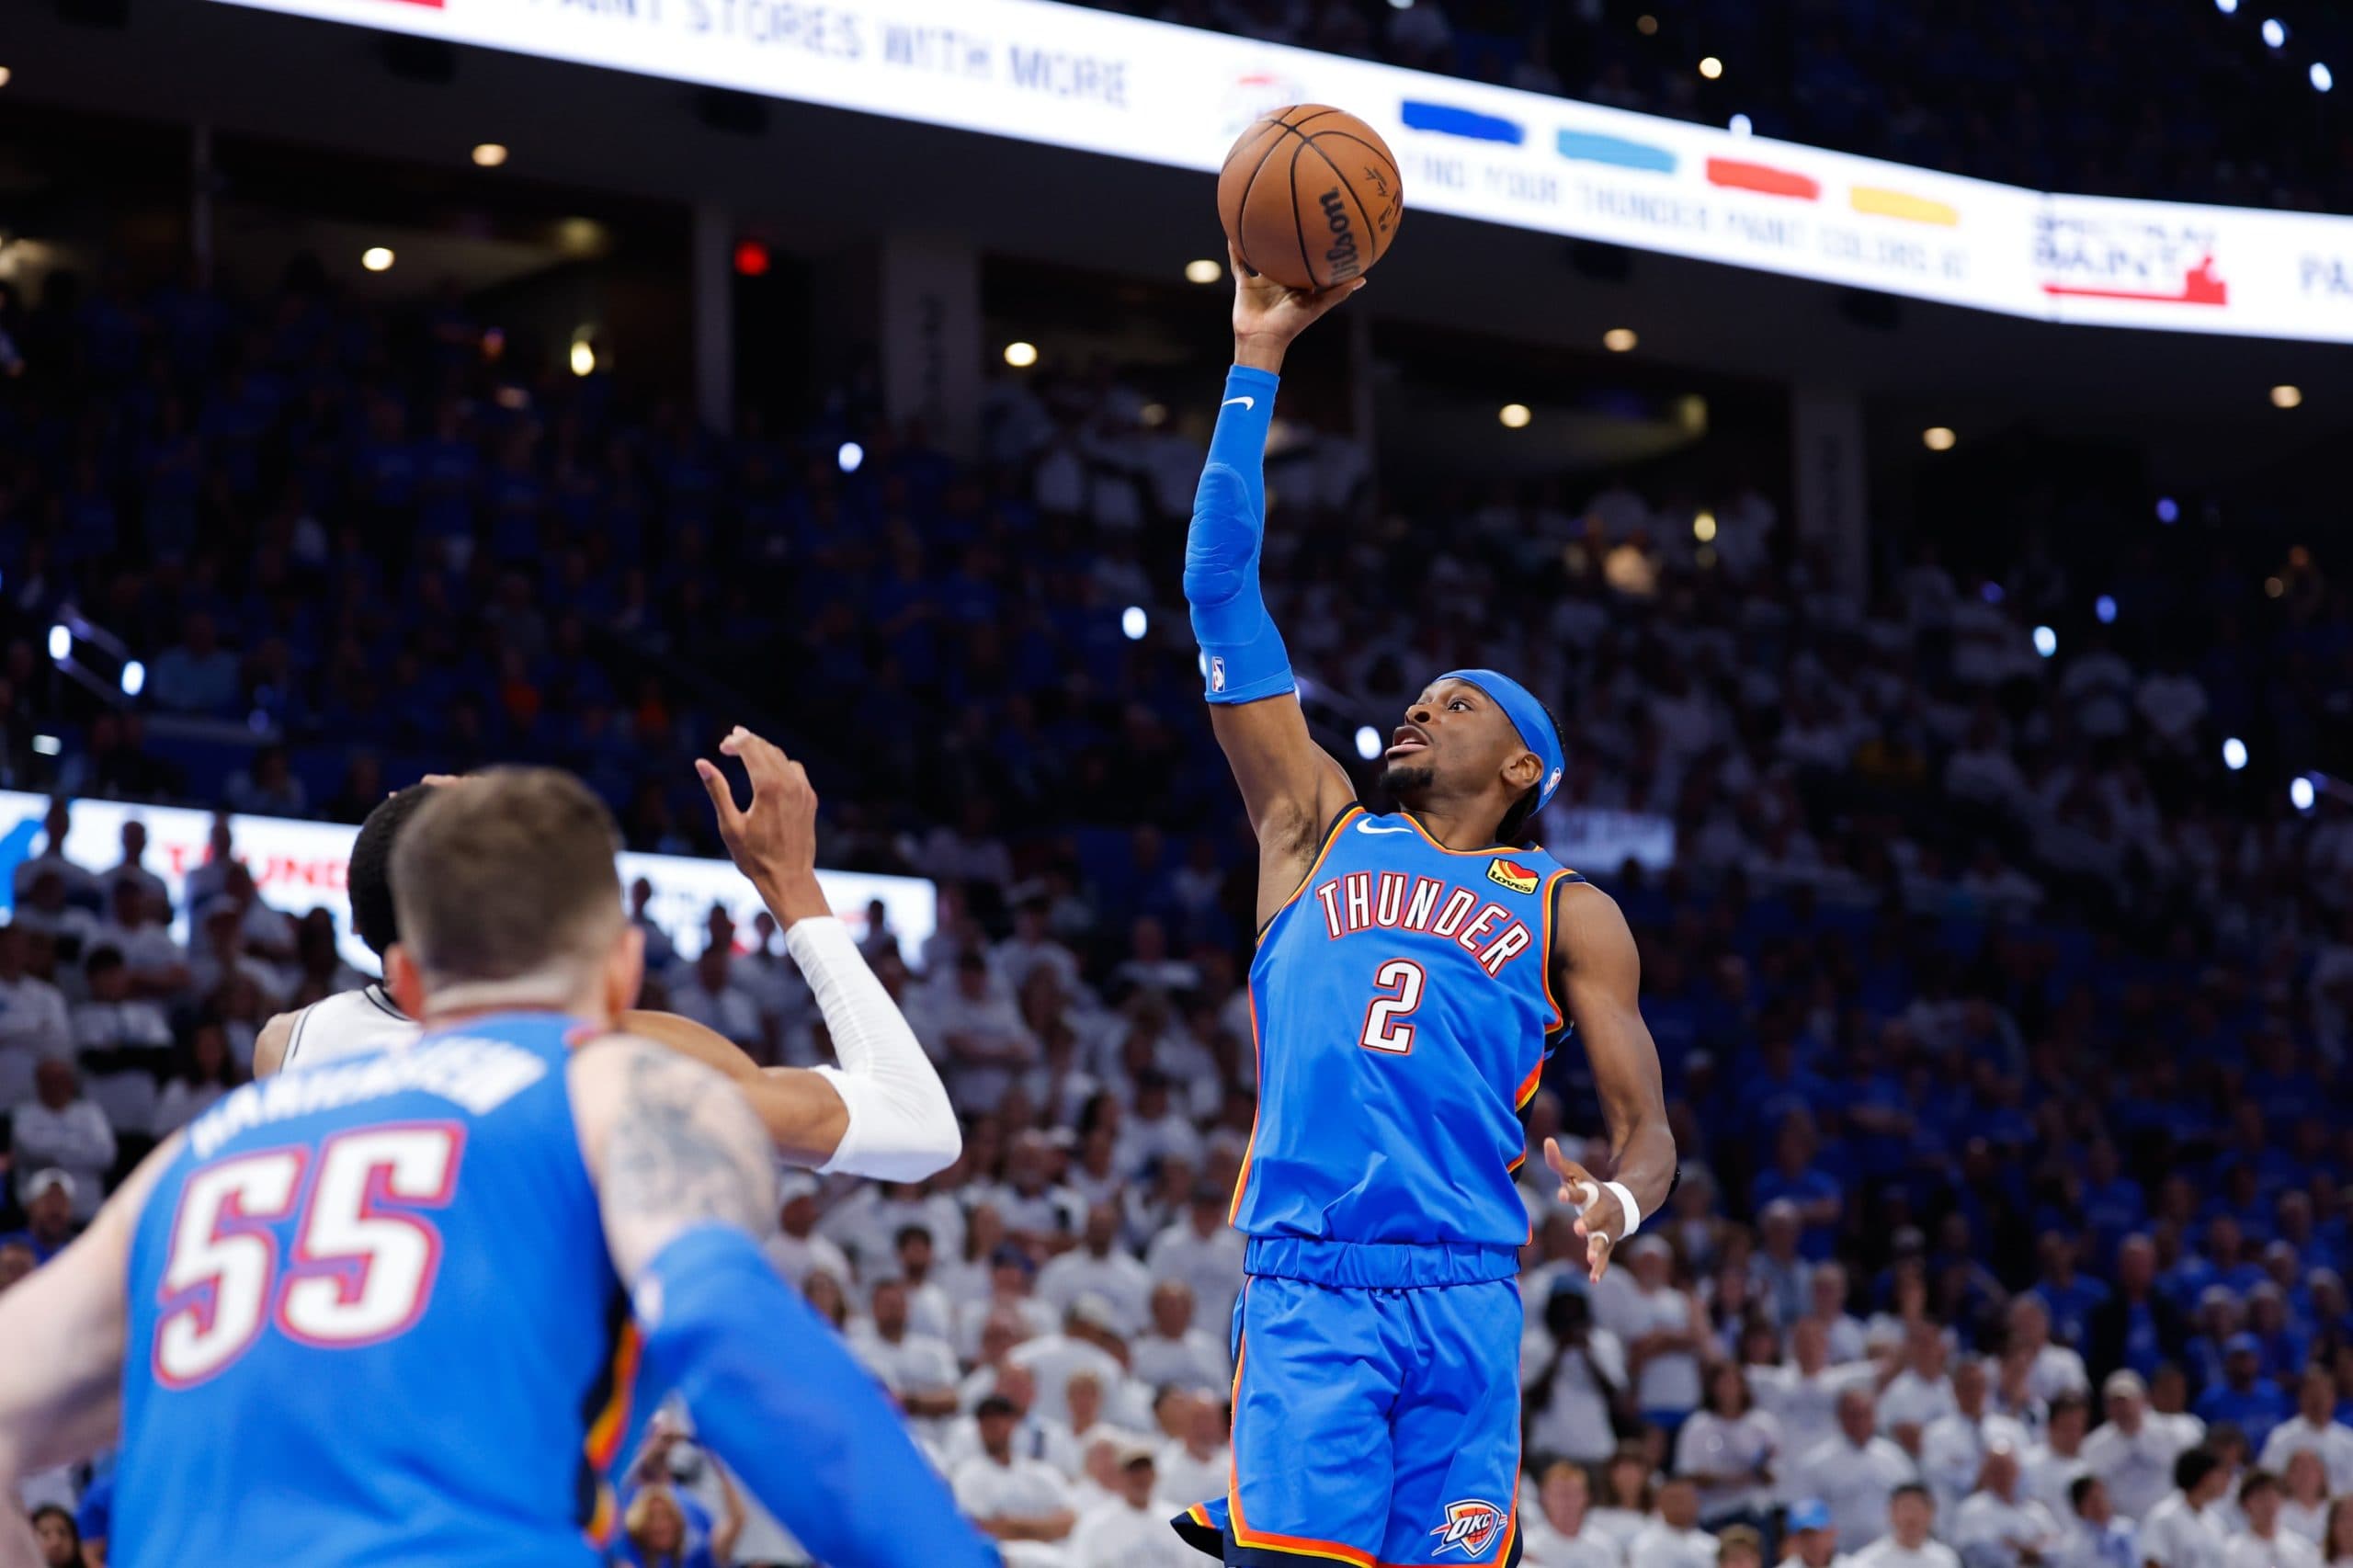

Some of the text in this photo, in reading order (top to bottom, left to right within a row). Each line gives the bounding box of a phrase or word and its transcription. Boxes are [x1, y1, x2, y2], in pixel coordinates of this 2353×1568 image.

[1316, 870, 1532, 979] THUNDER
[1359, 958, 1427, 1056] 2
[152, 1118, 468, 1391] 55
[1445, 1513, 1493, 1542] OKC
